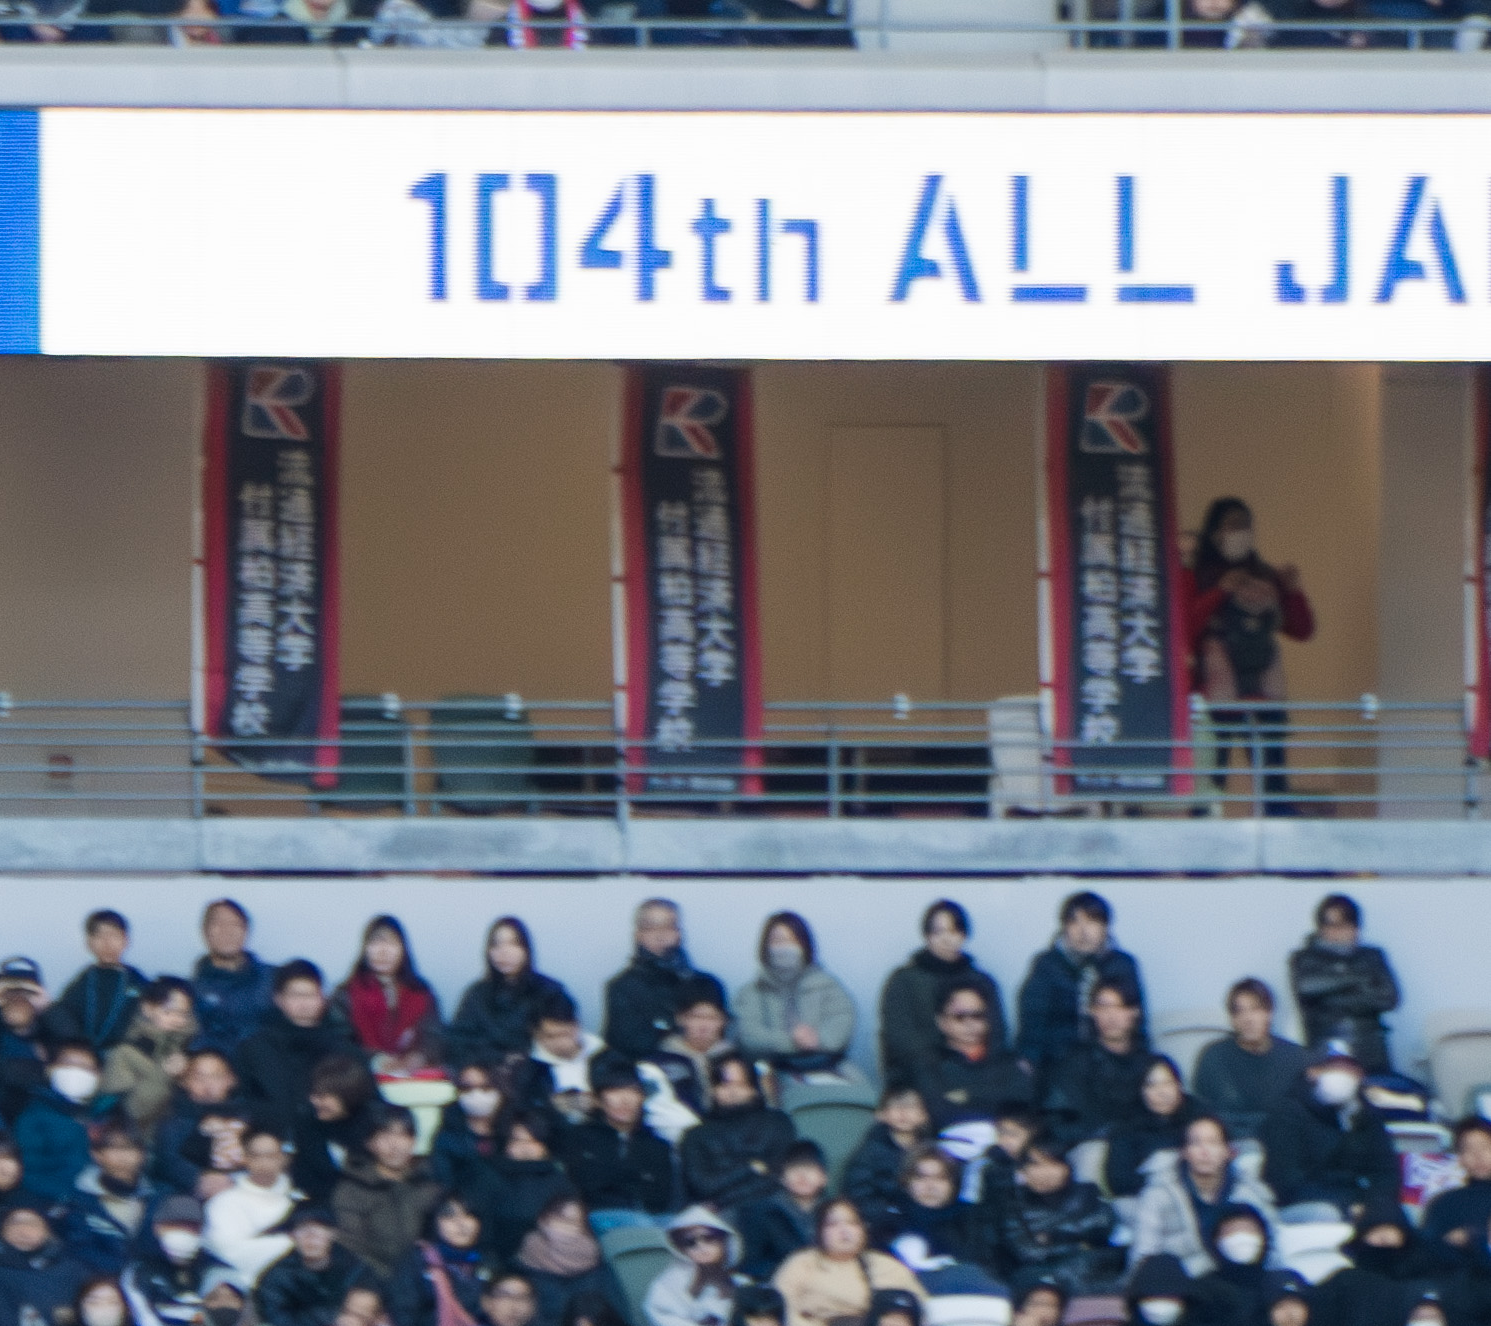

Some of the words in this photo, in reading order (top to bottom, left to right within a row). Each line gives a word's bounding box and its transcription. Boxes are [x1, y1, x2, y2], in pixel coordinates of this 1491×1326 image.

[411, 172, 820, 303] 104th
[891, 174, 1195, 304] ALL
[1274, 173, 1491, 304] JA
